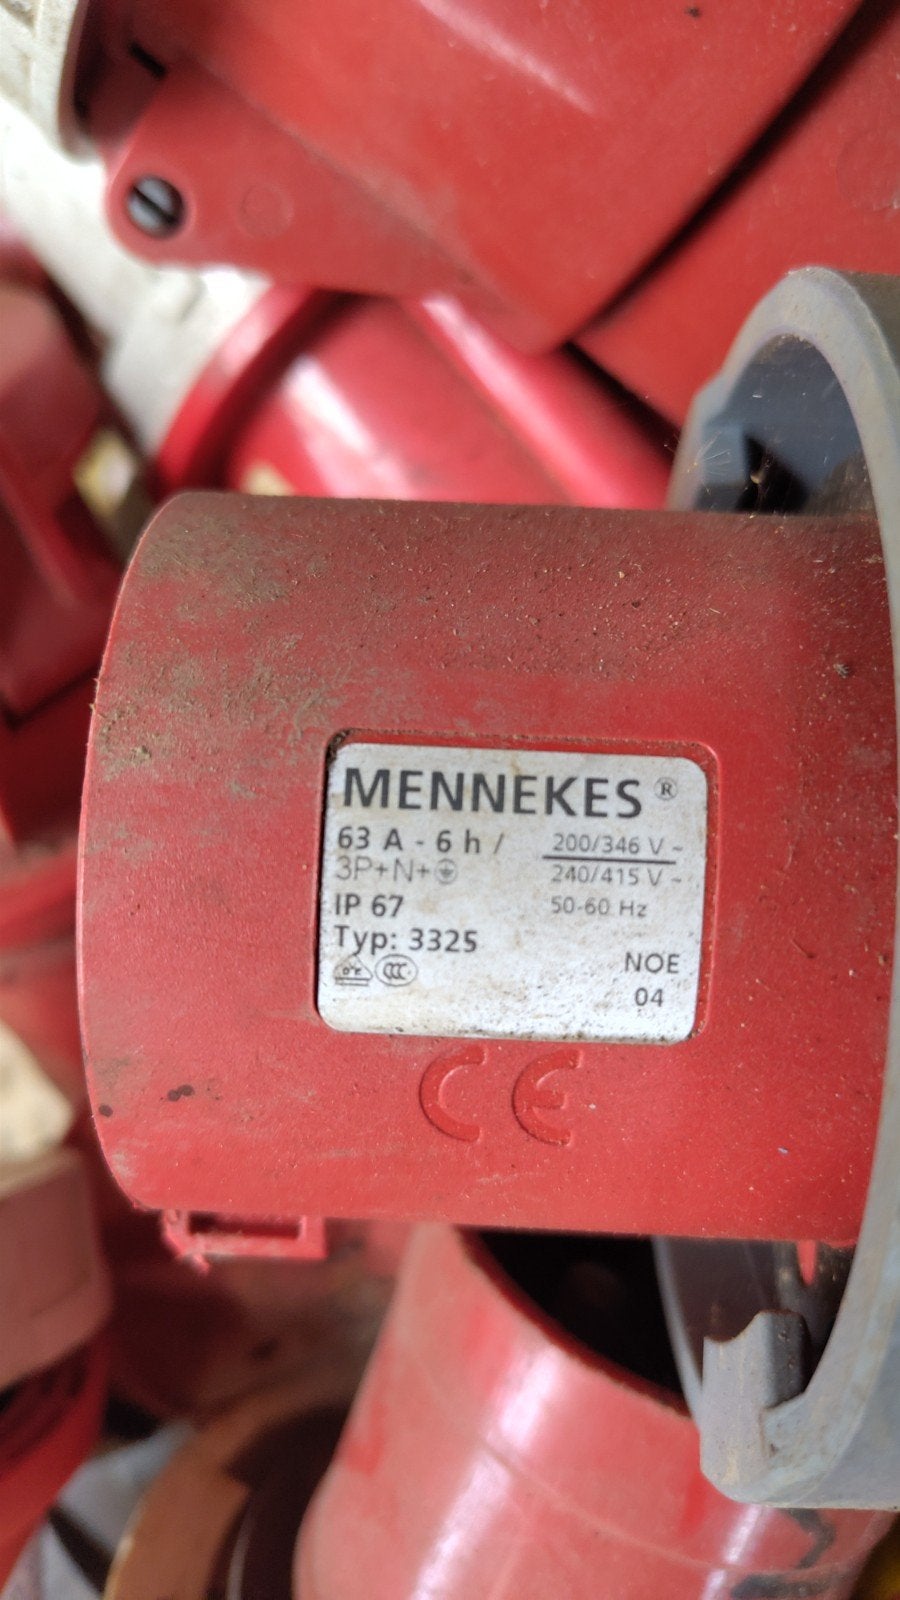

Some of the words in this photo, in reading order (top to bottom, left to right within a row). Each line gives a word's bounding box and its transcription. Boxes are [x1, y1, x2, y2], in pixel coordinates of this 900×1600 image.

[343, 766, 642, 819] MENNEKES
[338, 826, 370, 849] 63
[384, 828, 403, 851] A
[436, 829, 452, 853] 6
[465, 829, 480, 853] h
[494, 831, 505, 854] /
[553, 832, 640, 855] 200/346
[649, 837, 664, 855] V
[551, 864, 639, 885] 240/415
[648, 869, 662, 887] V
[335, 894, 361, 915] IP
[371, 895, 404, 917] 67
[552, 896, 610, 916] 50-60
[619, 900, 647, 918] Hz
[334, 925, 397, 955] Typ:
[409, 928, 478, 953] 3325
[624, 952, 680, 974] NOE
[635, 987, 664, 1007] 04
[418, 1045, 583, 1147] CE
